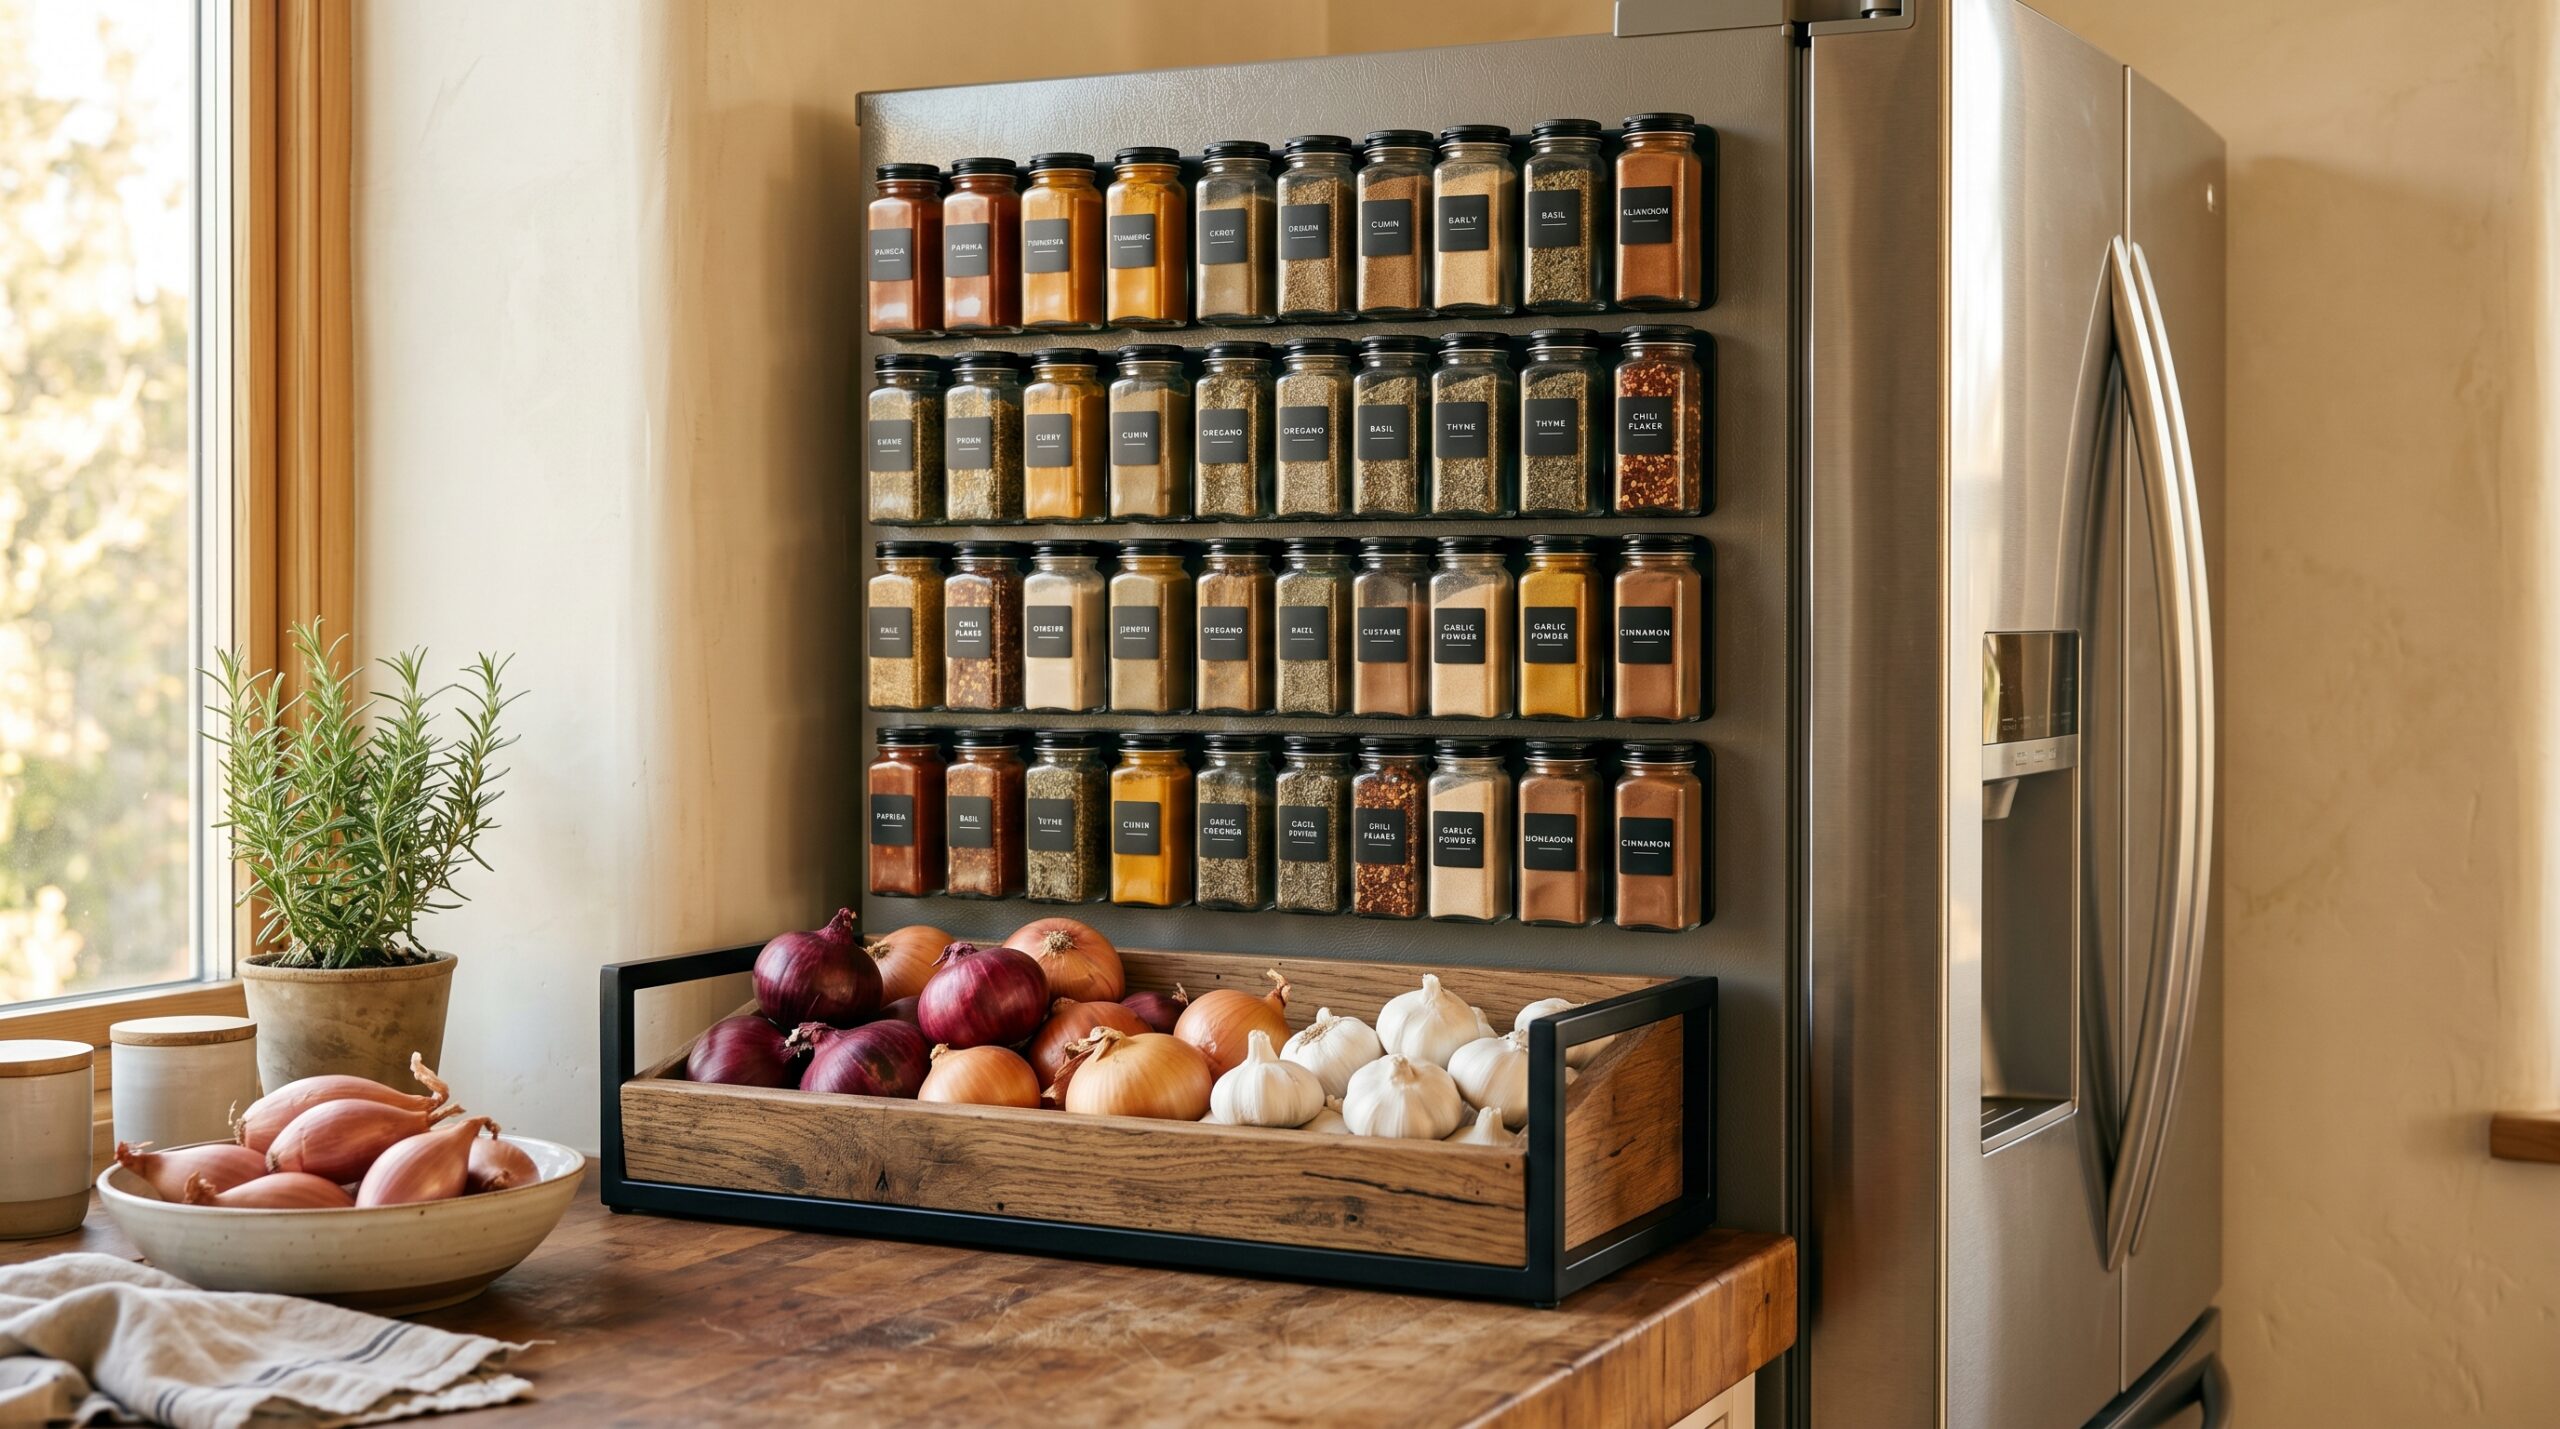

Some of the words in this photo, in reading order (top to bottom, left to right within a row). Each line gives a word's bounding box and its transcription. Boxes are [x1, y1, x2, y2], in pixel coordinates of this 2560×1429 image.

[1202, 429, 1243, 437] OREGANO
[1283, 427, 1324, 435] OREGANO
[1370, 425, 1394, 433] BASIL
[1122, 431, 1148, 439] CUMIN
[1363, 628, 1401, 636] CUSTAME
